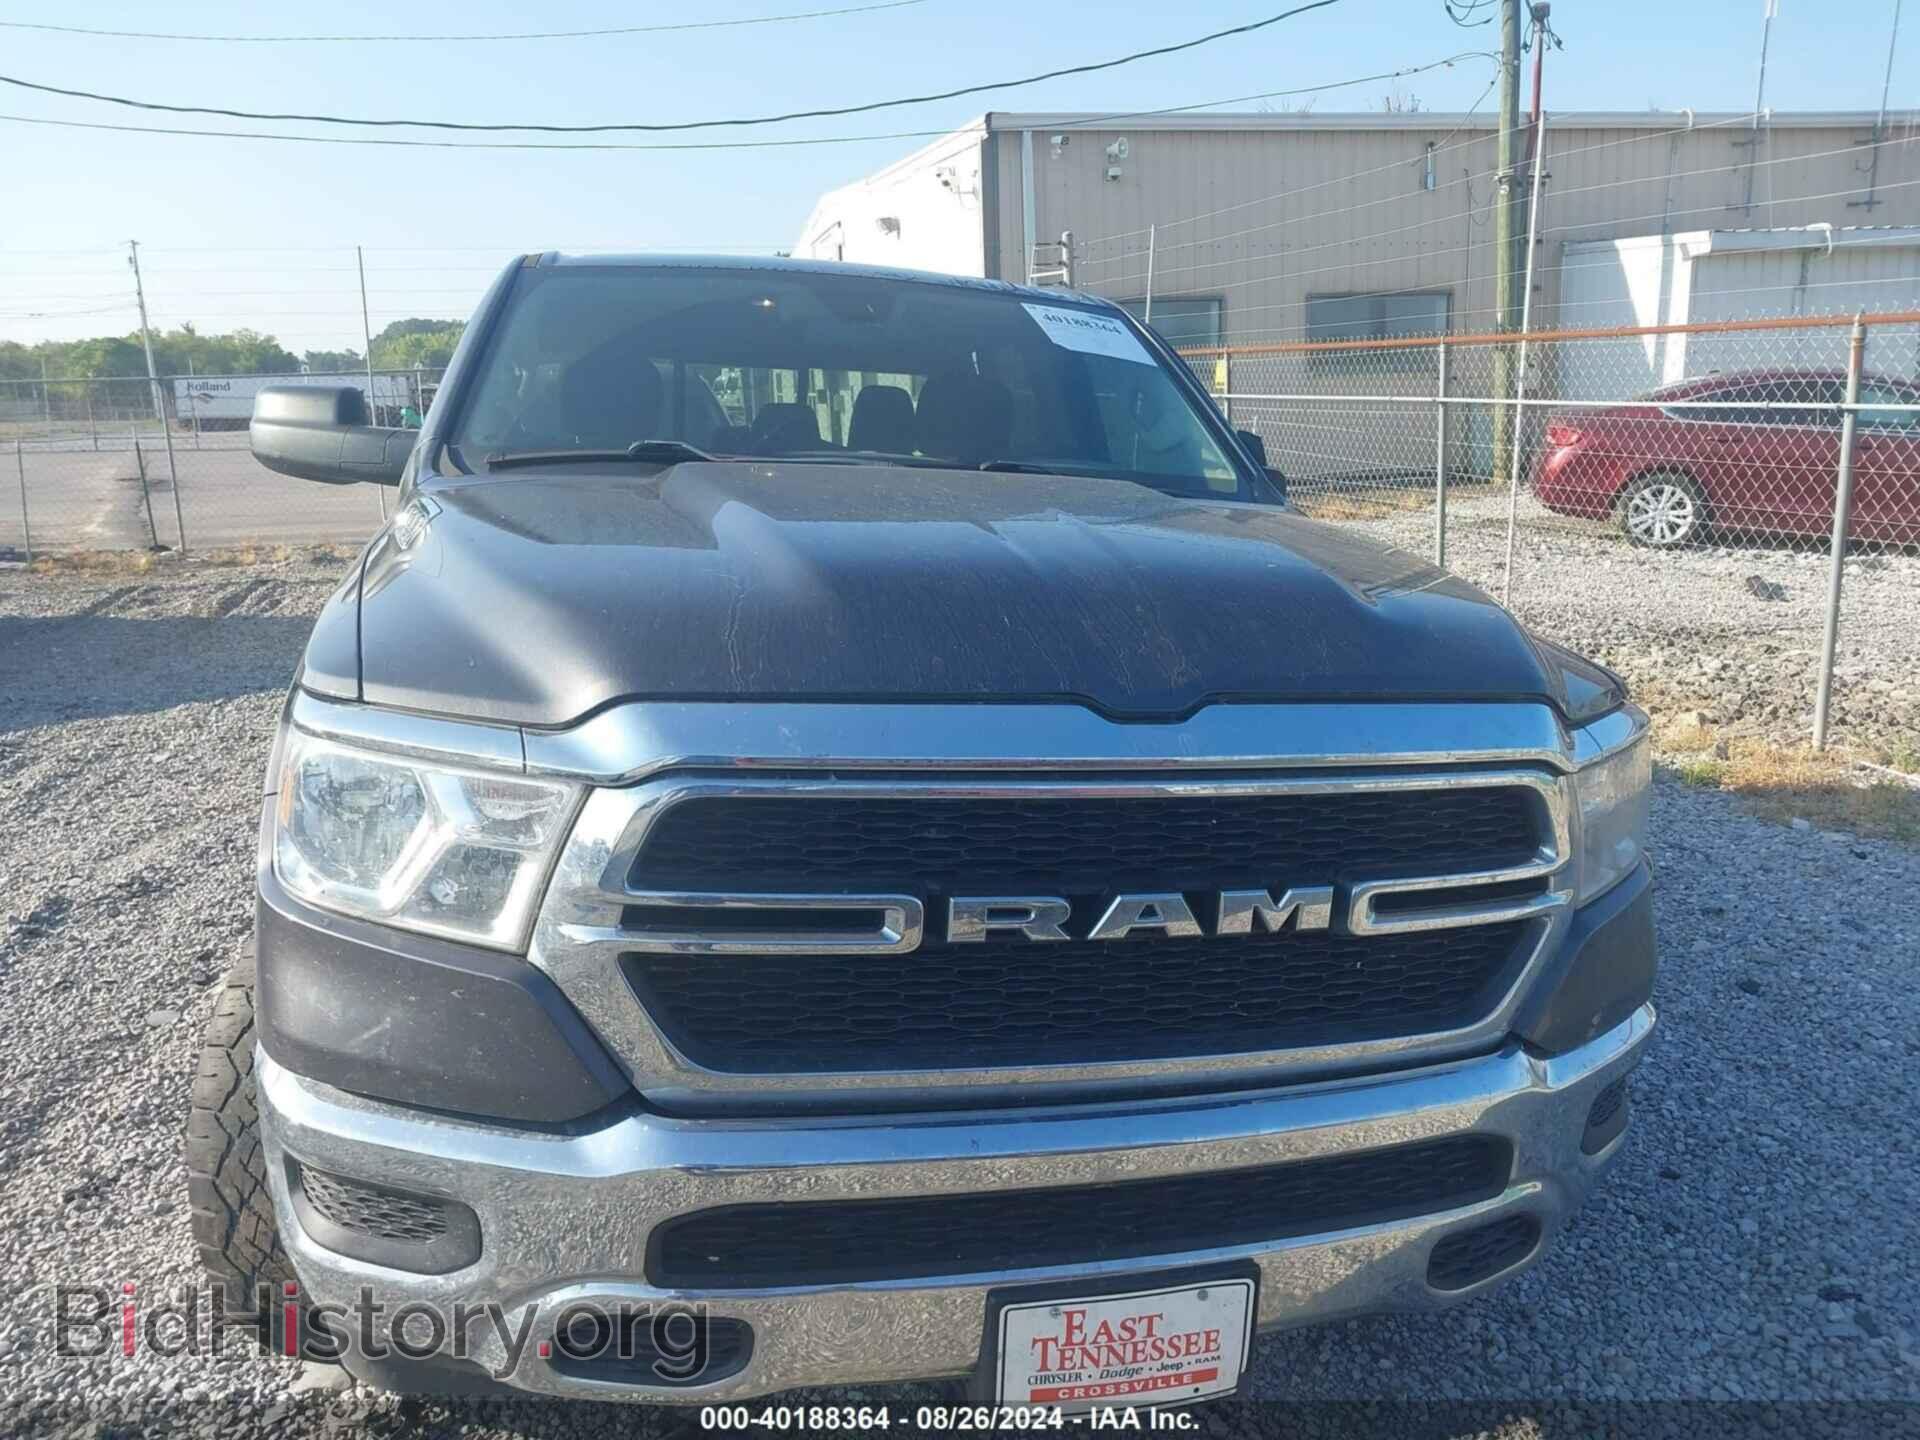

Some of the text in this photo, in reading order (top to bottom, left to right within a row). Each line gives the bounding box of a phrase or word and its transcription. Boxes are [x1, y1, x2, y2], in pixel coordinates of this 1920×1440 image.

[947, 886, 1333, 943] RAM
[1061, 1309, 1163, 1347] EAST
[1027, 1354, 1221, 1386] CHRYSLER Dodge Jeep RAM
[1032, 1329, 1221, 1373] TENNESSEE
[1058, 1374, 1193, 1399] CROSSVILLE
